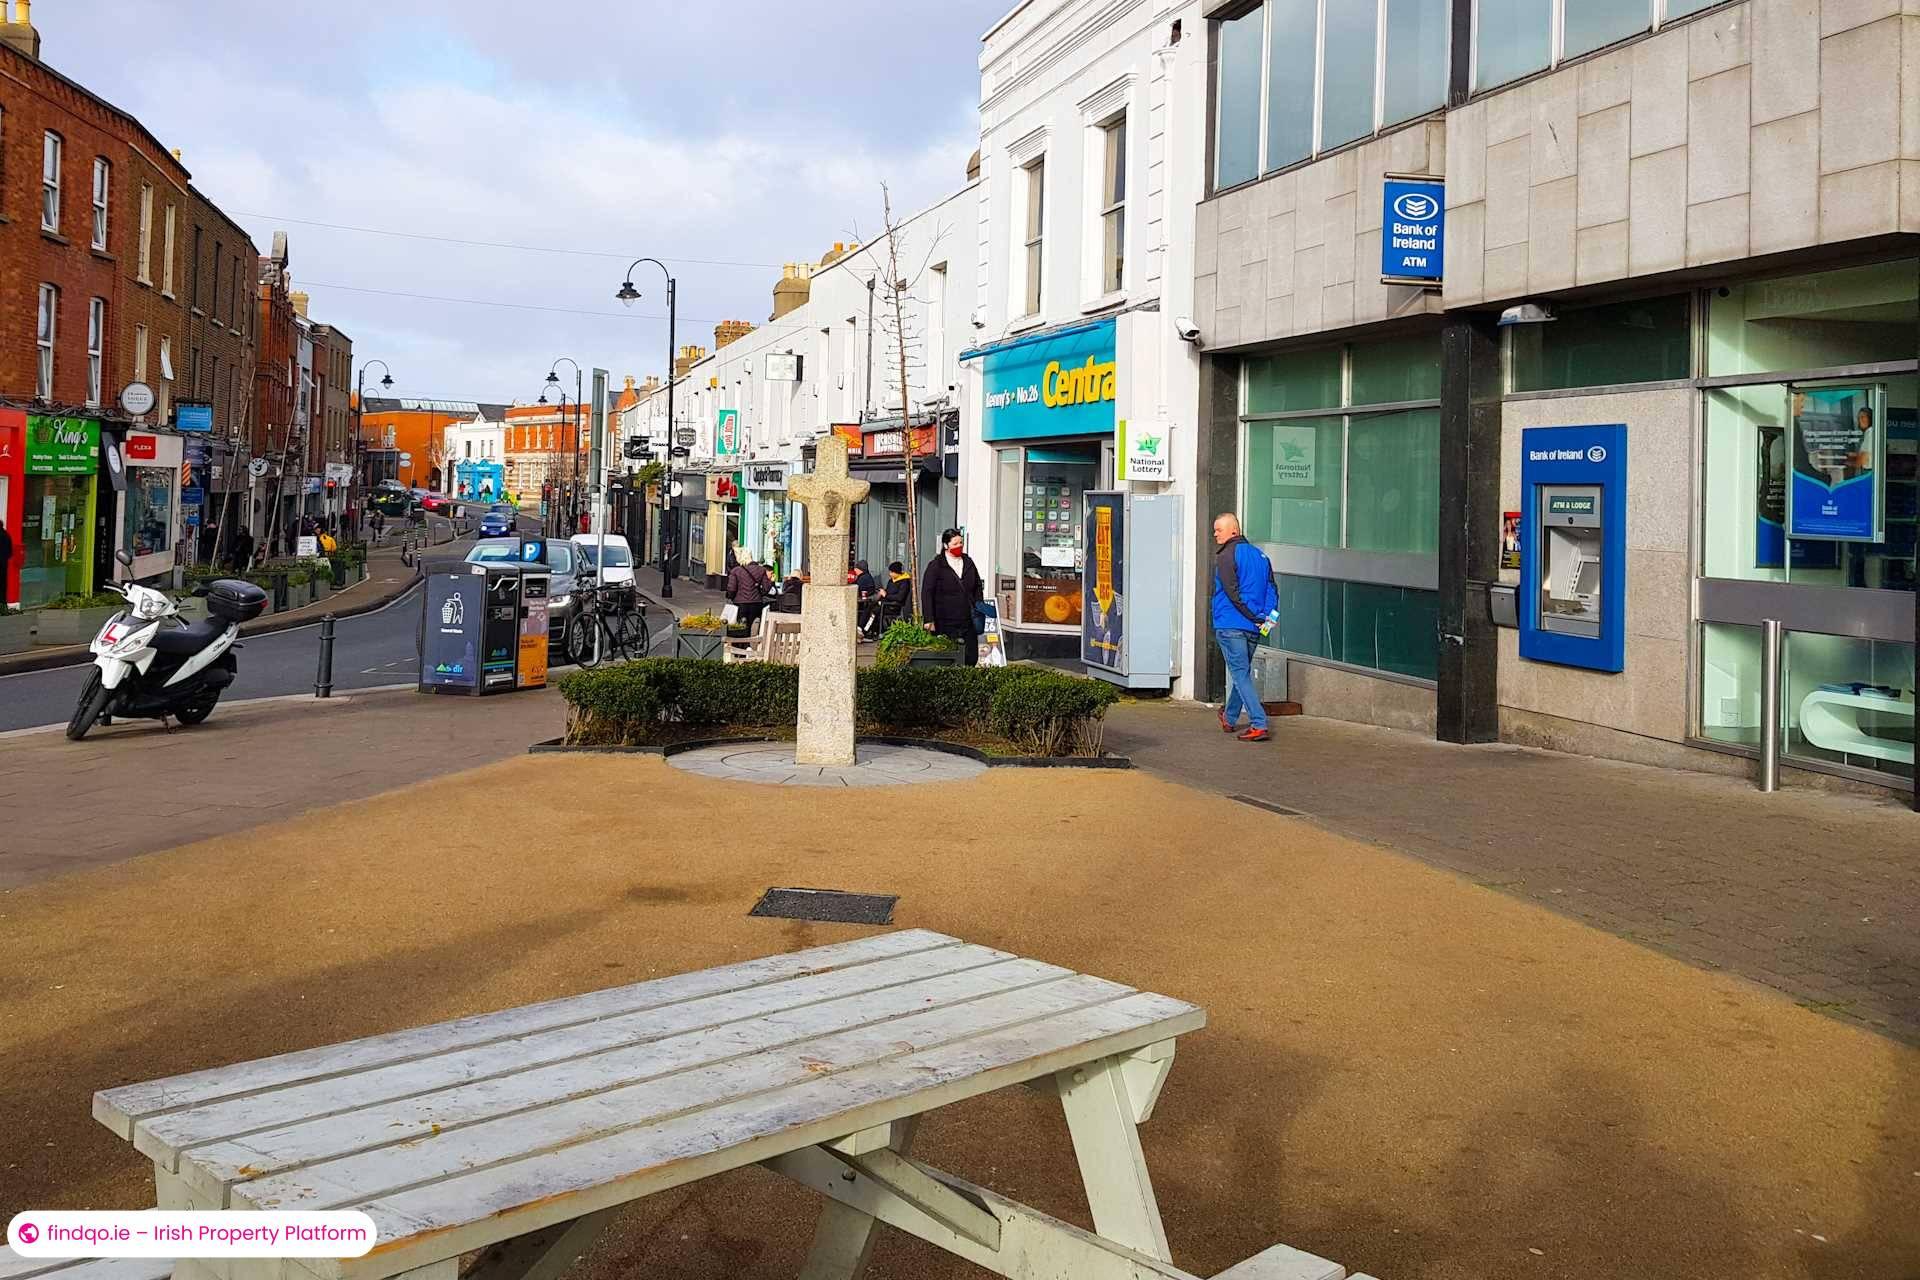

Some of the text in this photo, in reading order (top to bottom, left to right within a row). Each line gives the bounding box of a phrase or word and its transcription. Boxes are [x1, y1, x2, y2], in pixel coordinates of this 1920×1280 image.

[1393, 223, 1438, 236] Bank of
[1392, 237, 1436, 250] Ireland
[1402, 257, 1427, 267] ATM
[1042, 354, 1115, 408] Centra
[53, 418, 88, 453] King's
[1529, 449, 1583, 460] Bank of Ireland
[1130, 458, 1165, 466] National
[1132, 465, 1163, 475] Lottery
[1571, 501, 1591, 509] LODGE
[525, 543, 536, 560] P
[103, 624, 118, 645] L
